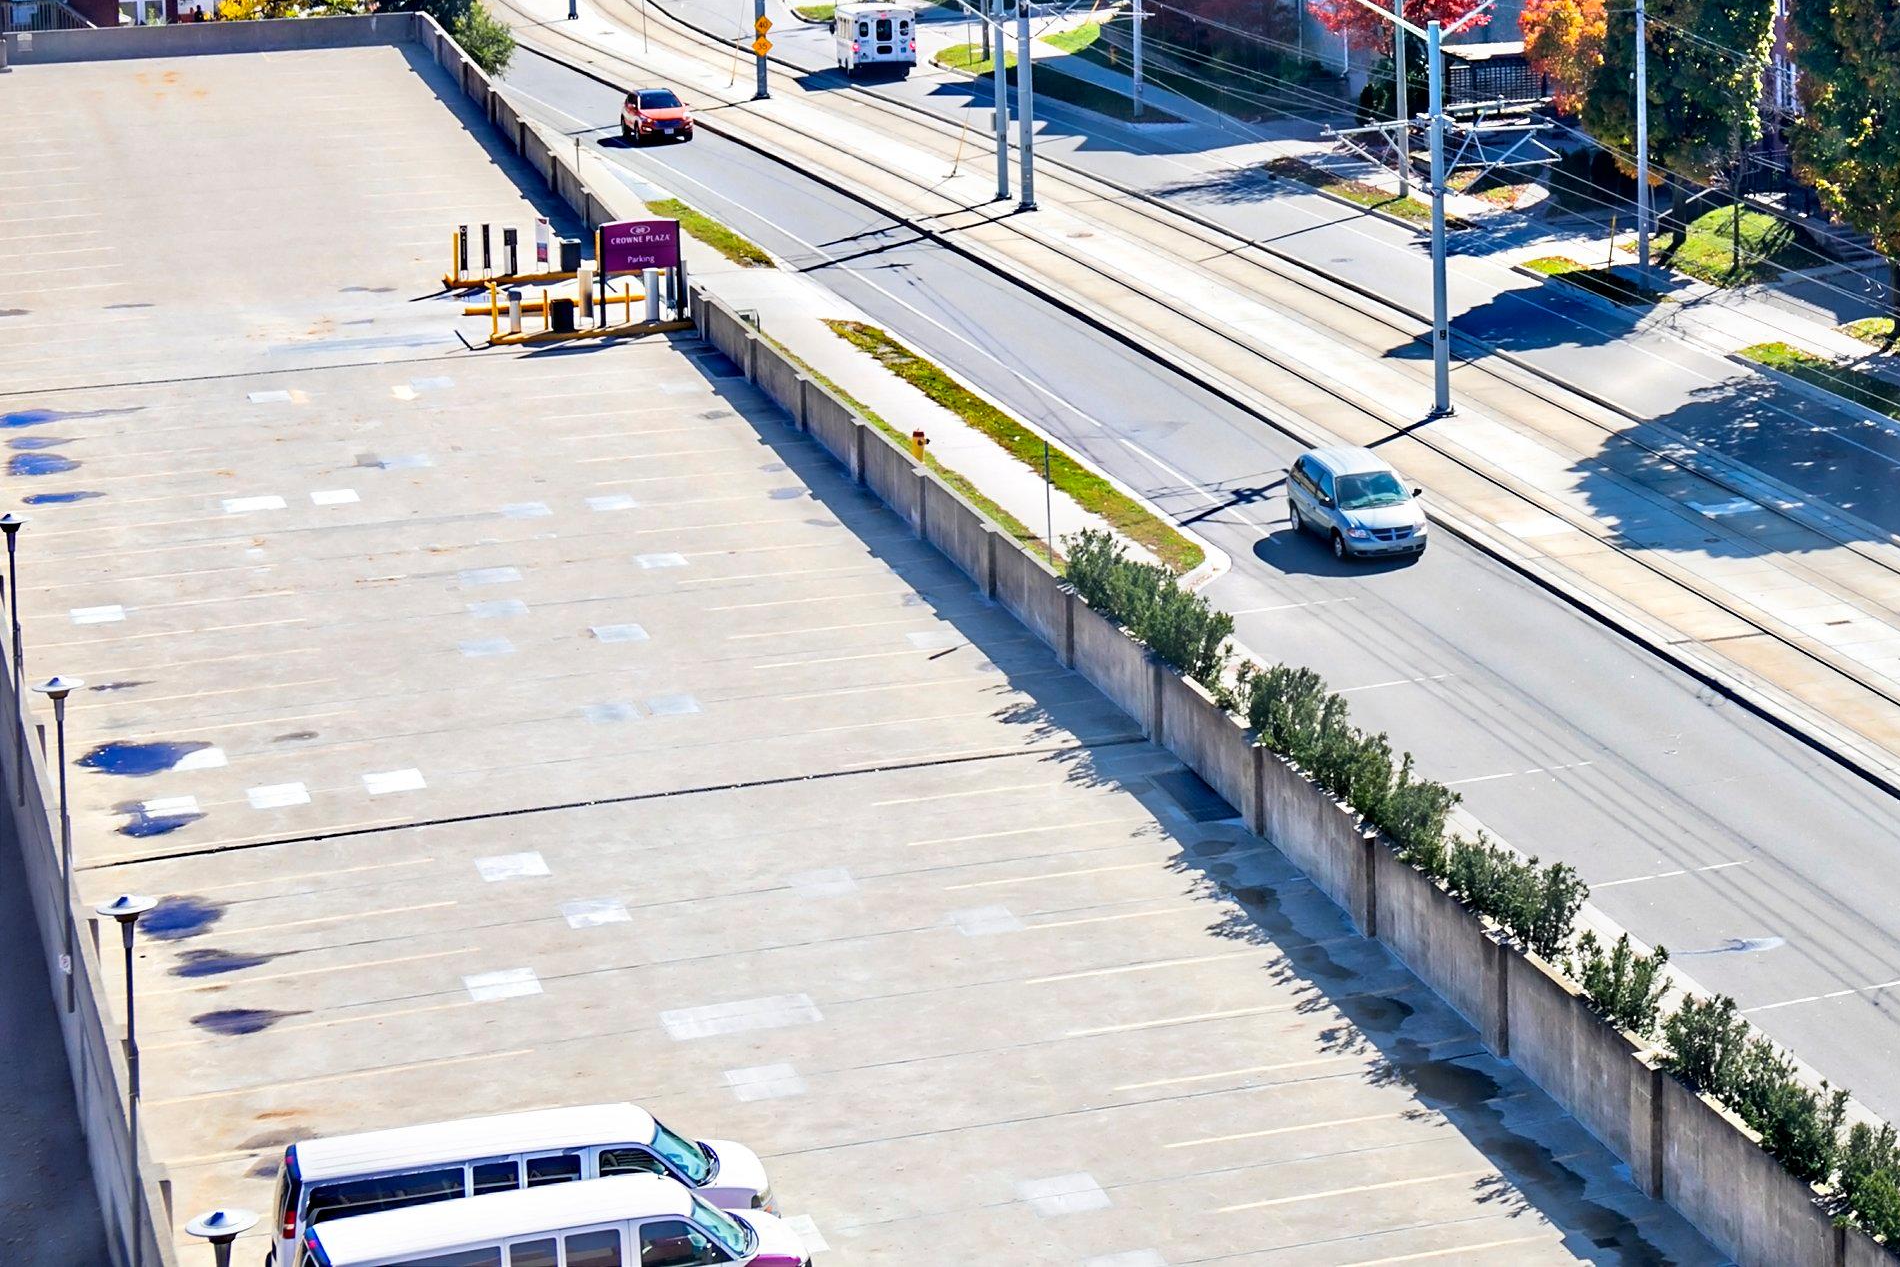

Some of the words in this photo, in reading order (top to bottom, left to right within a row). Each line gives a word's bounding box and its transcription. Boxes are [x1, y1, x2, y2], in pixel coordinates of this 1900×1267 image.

[611, 235, 643, 245] CROWNE
[646, 233, 670, 242] PLAZA
[627, 255, 655, 264] Parking
